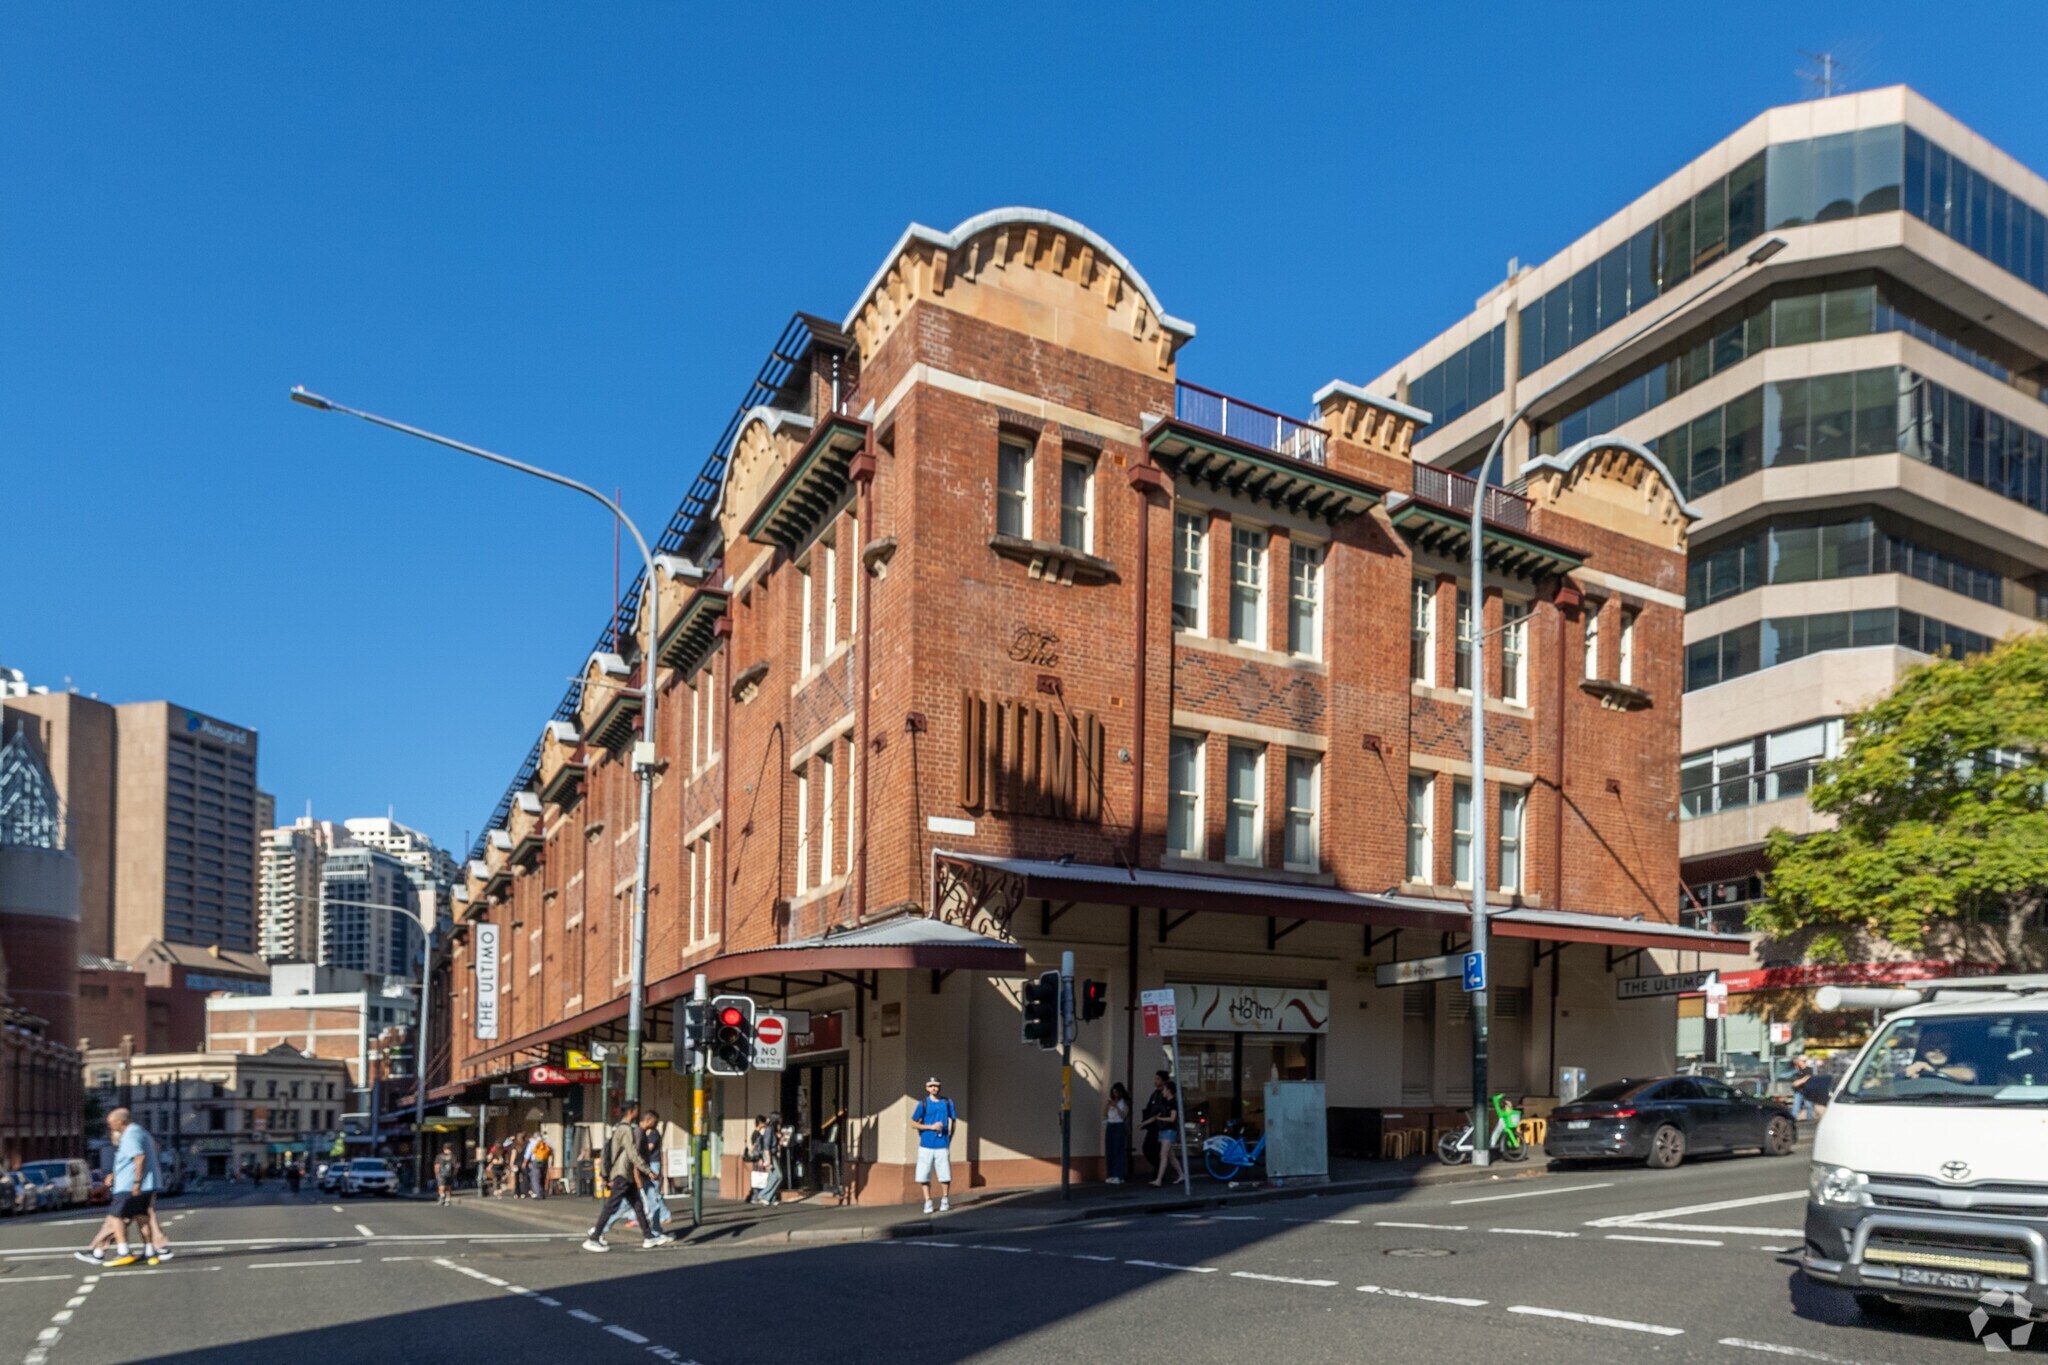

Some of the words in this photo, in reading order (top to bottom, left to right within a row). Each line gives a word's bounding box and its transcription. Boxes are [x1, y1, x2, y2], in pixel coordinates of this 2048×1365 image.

[1008, 627, 1059, 667] The
[480, 931, 495, 993] ULTIMO
[1623, 978, 1648, 994] THE
[1653, 974, 1707, 992] ULTIMO
[479, 1001, 493, 1029] THE
[755, 1057, 781, 1066] ENTRY
[761, 1047, 777, 1056] NO
